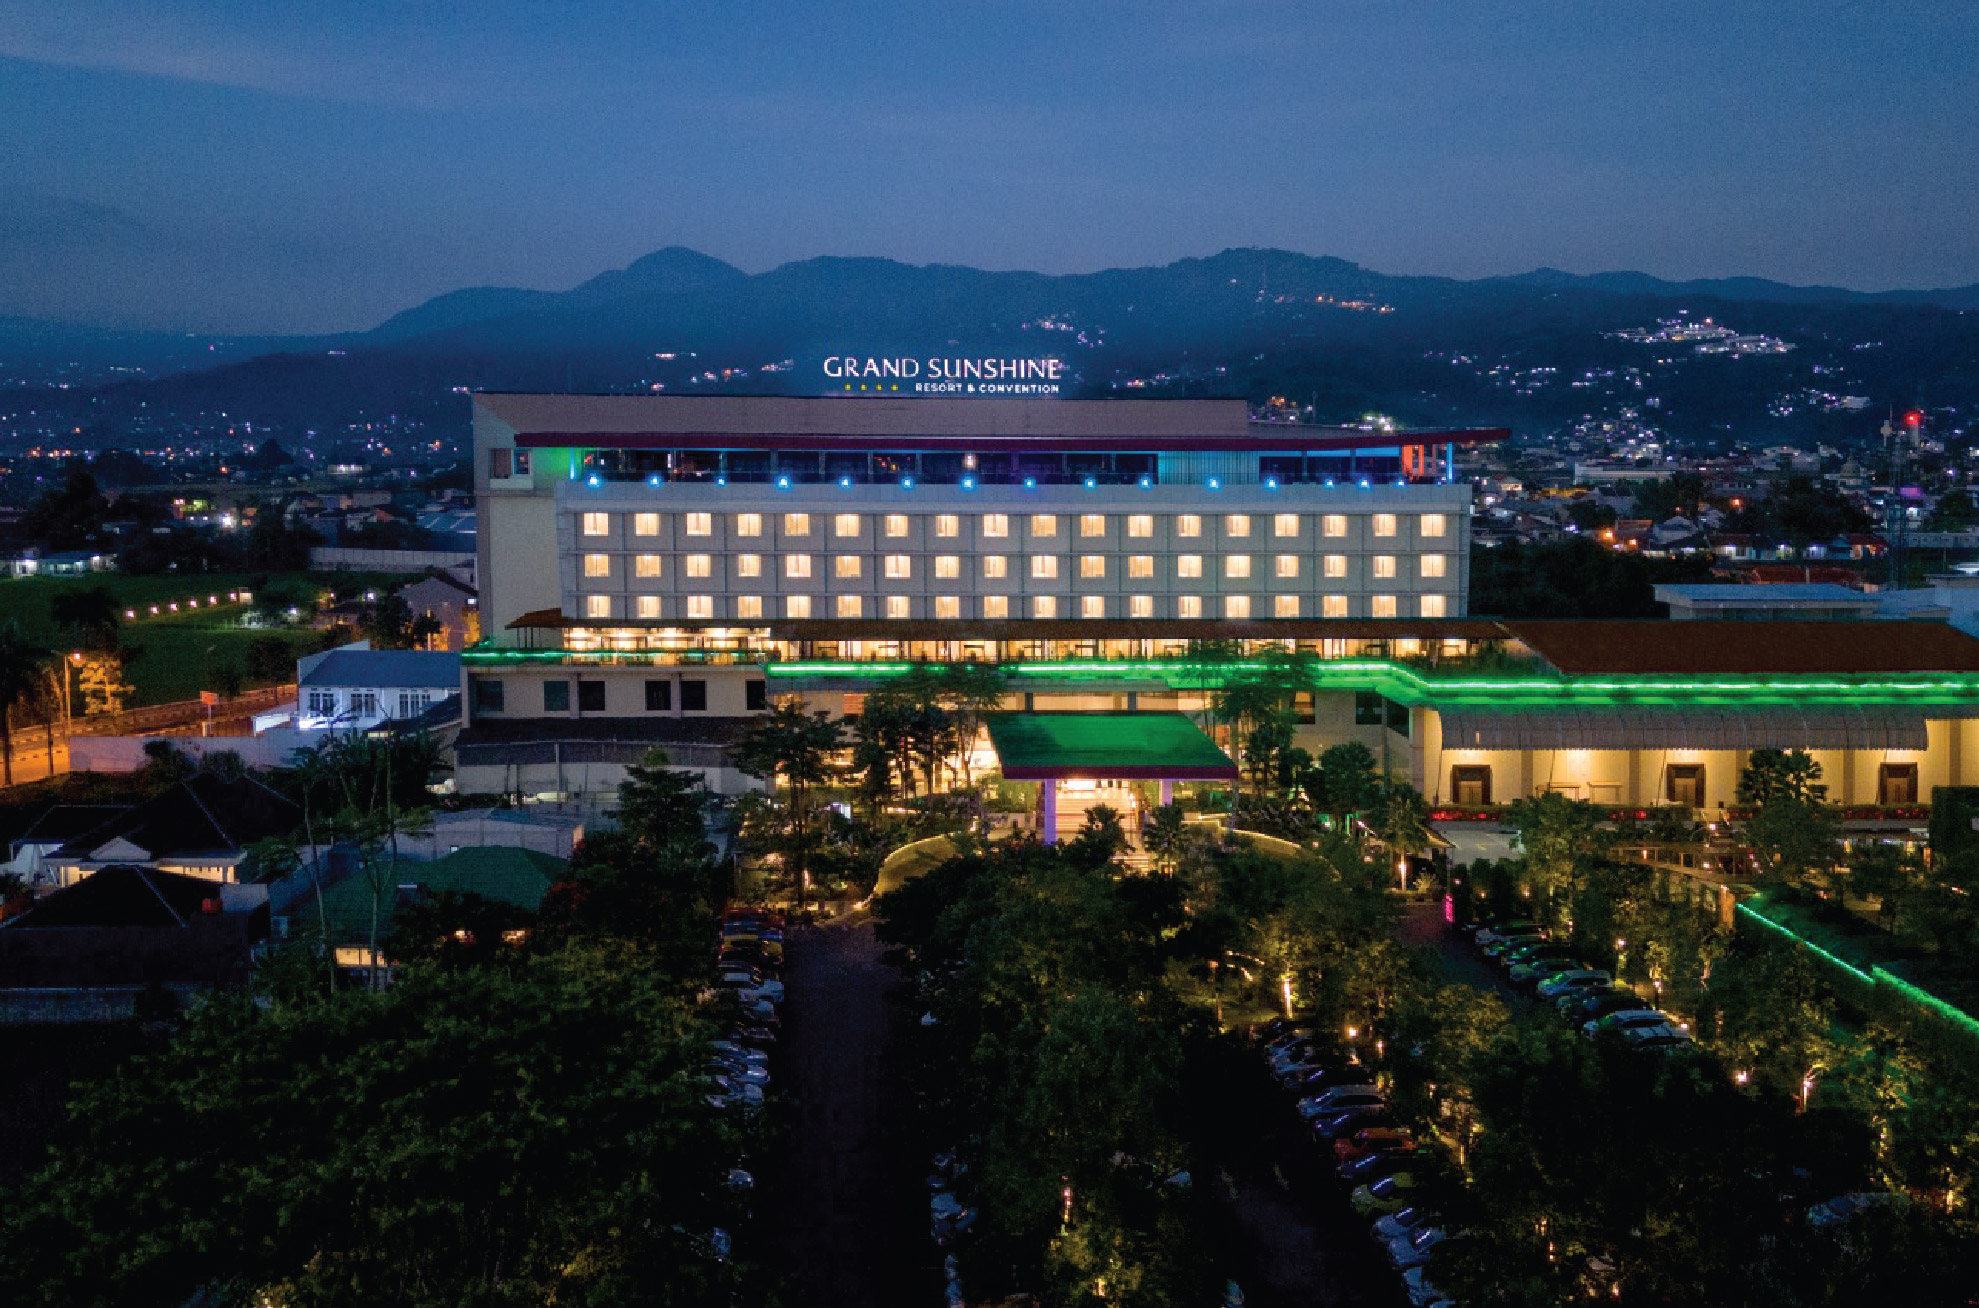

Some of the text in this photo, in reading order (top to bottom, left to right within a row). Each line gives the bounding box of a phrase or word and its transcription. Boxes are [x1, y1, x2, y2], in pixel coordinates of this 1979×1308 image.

[823, 356, 1062, 380] GRAND SUNSHINE
[915, 382, 962, 392] RESORT
[978, 383, 1059, 394] CONVENTION
